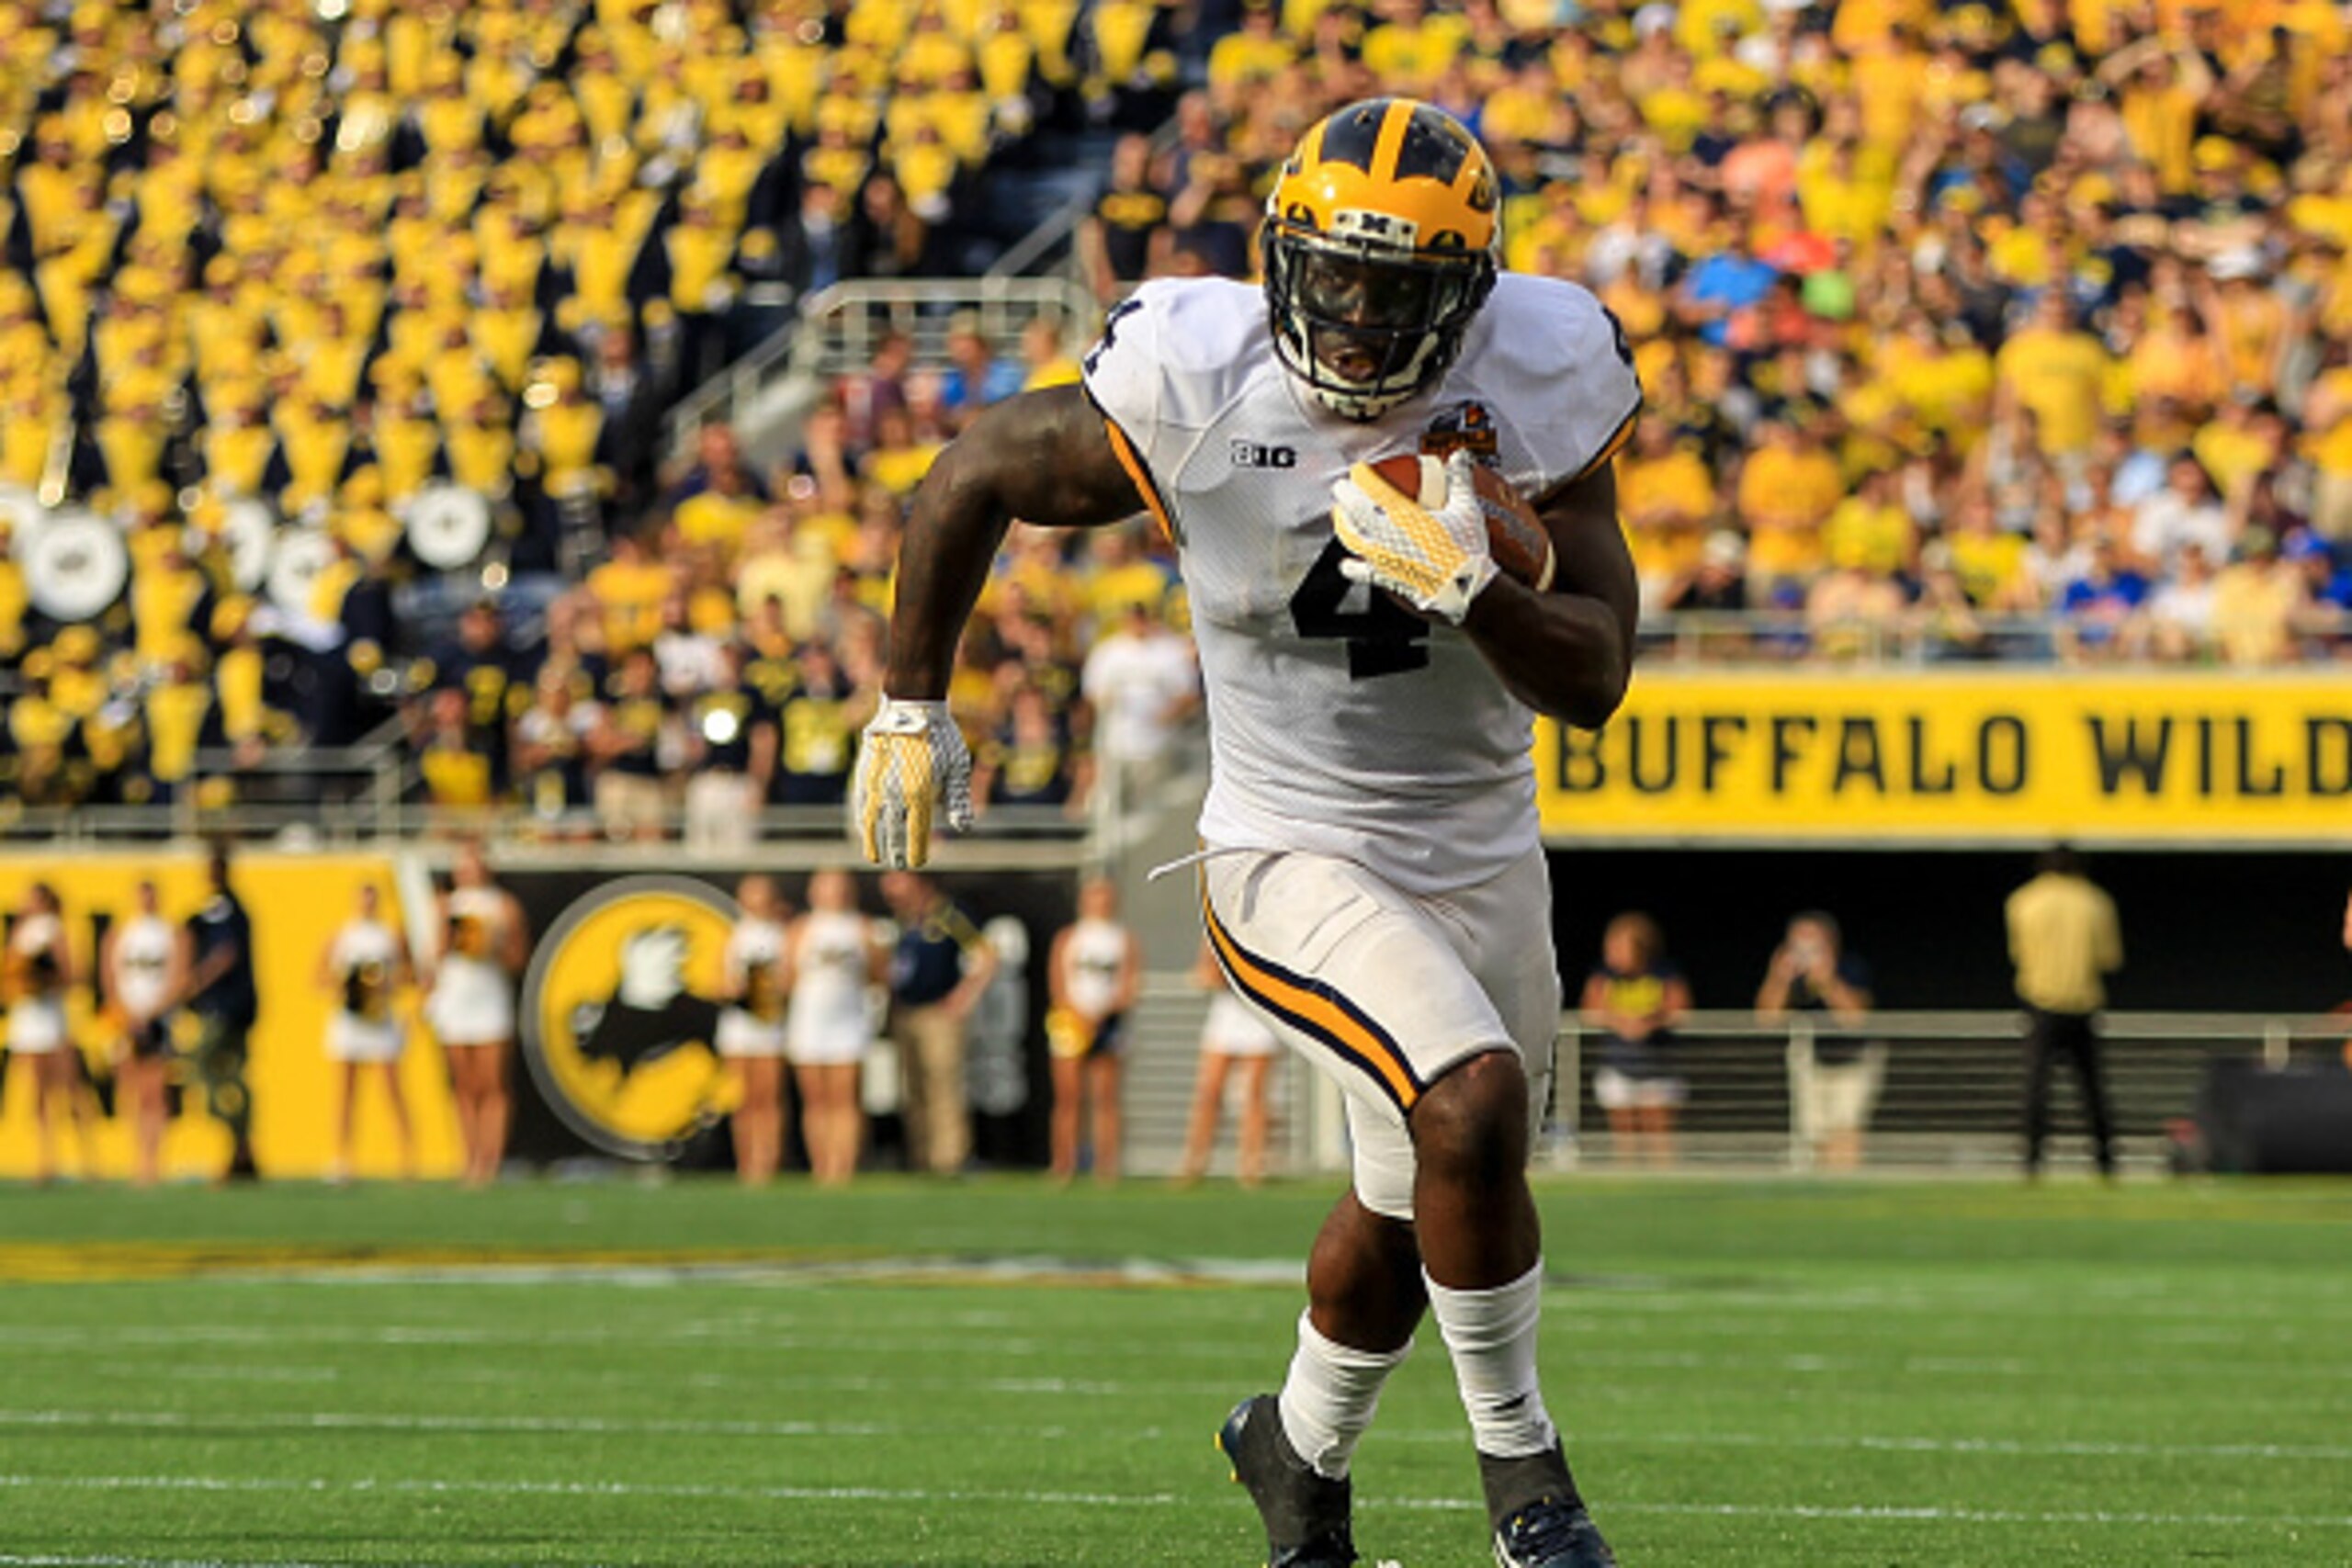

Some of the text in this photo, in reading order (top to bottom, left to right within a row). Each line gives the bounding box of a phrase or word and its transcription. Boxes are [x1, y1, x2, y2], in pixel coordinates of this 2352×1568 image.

[1289, 534, 1430, 681] 4
[1558, 714, 2352, 795] BUFFALO WILD
